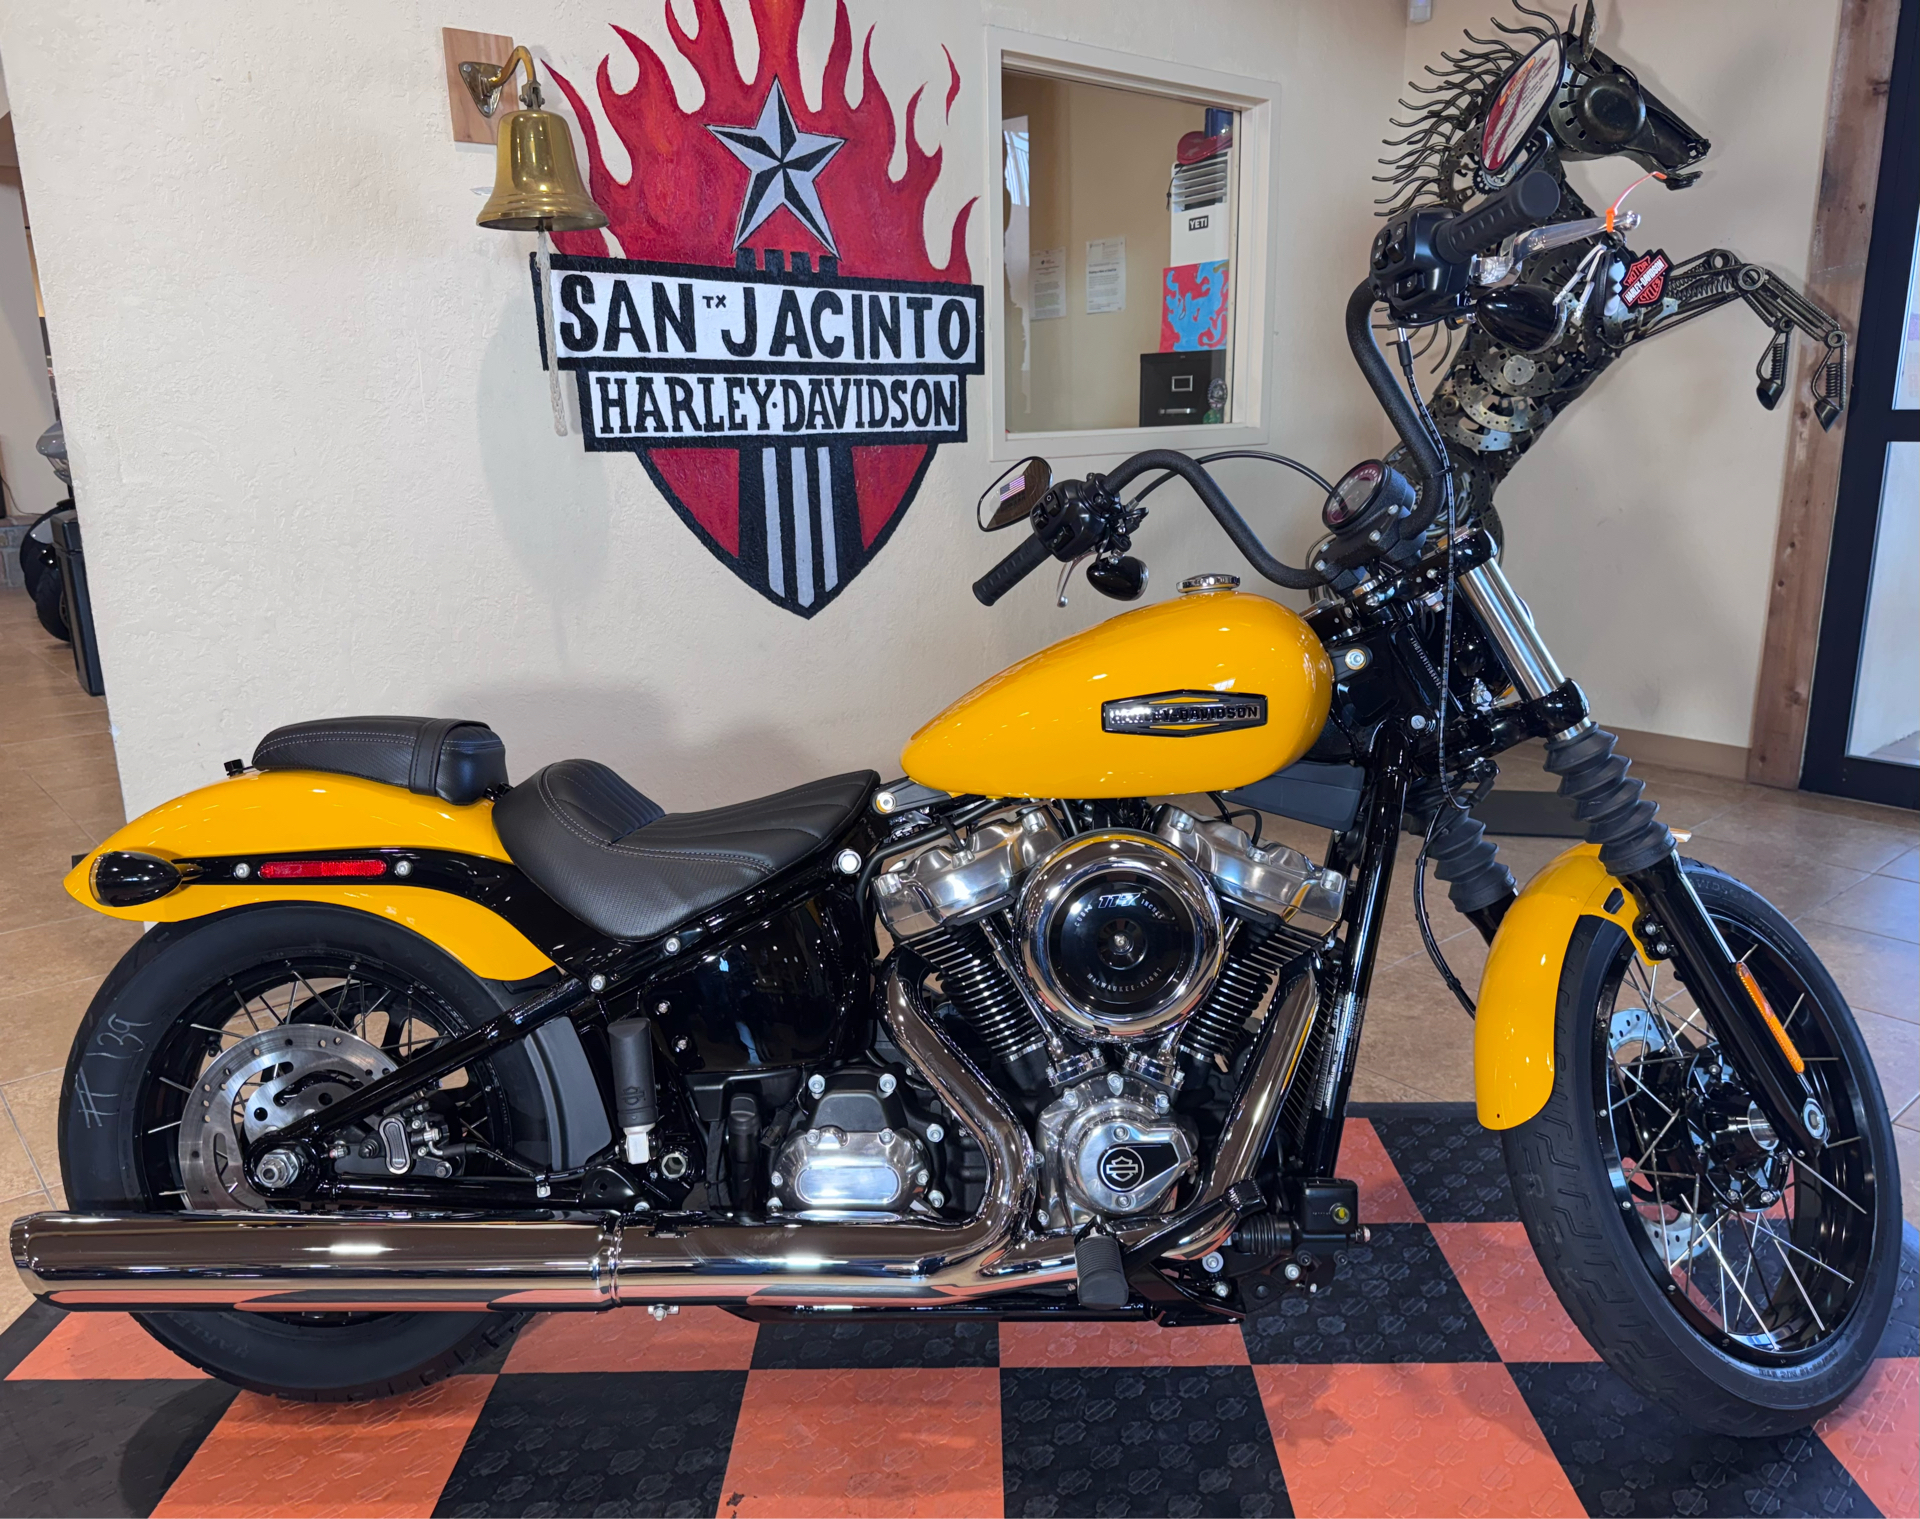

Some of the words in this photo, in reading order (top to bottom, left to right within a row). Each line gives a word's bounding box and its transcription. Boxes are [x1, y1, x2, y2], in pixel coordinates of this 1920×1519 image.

[1190, 218, 1208, 229] YETI
[702, 294, 727, 309] TX
[559, 274, 698, 353] SAN
[721, 286, 971, 361] JACINTO
[1098, 893, 1141, 908] 117
[1086, 967, 1162, 991] MILWAUKEE-EIGHT
